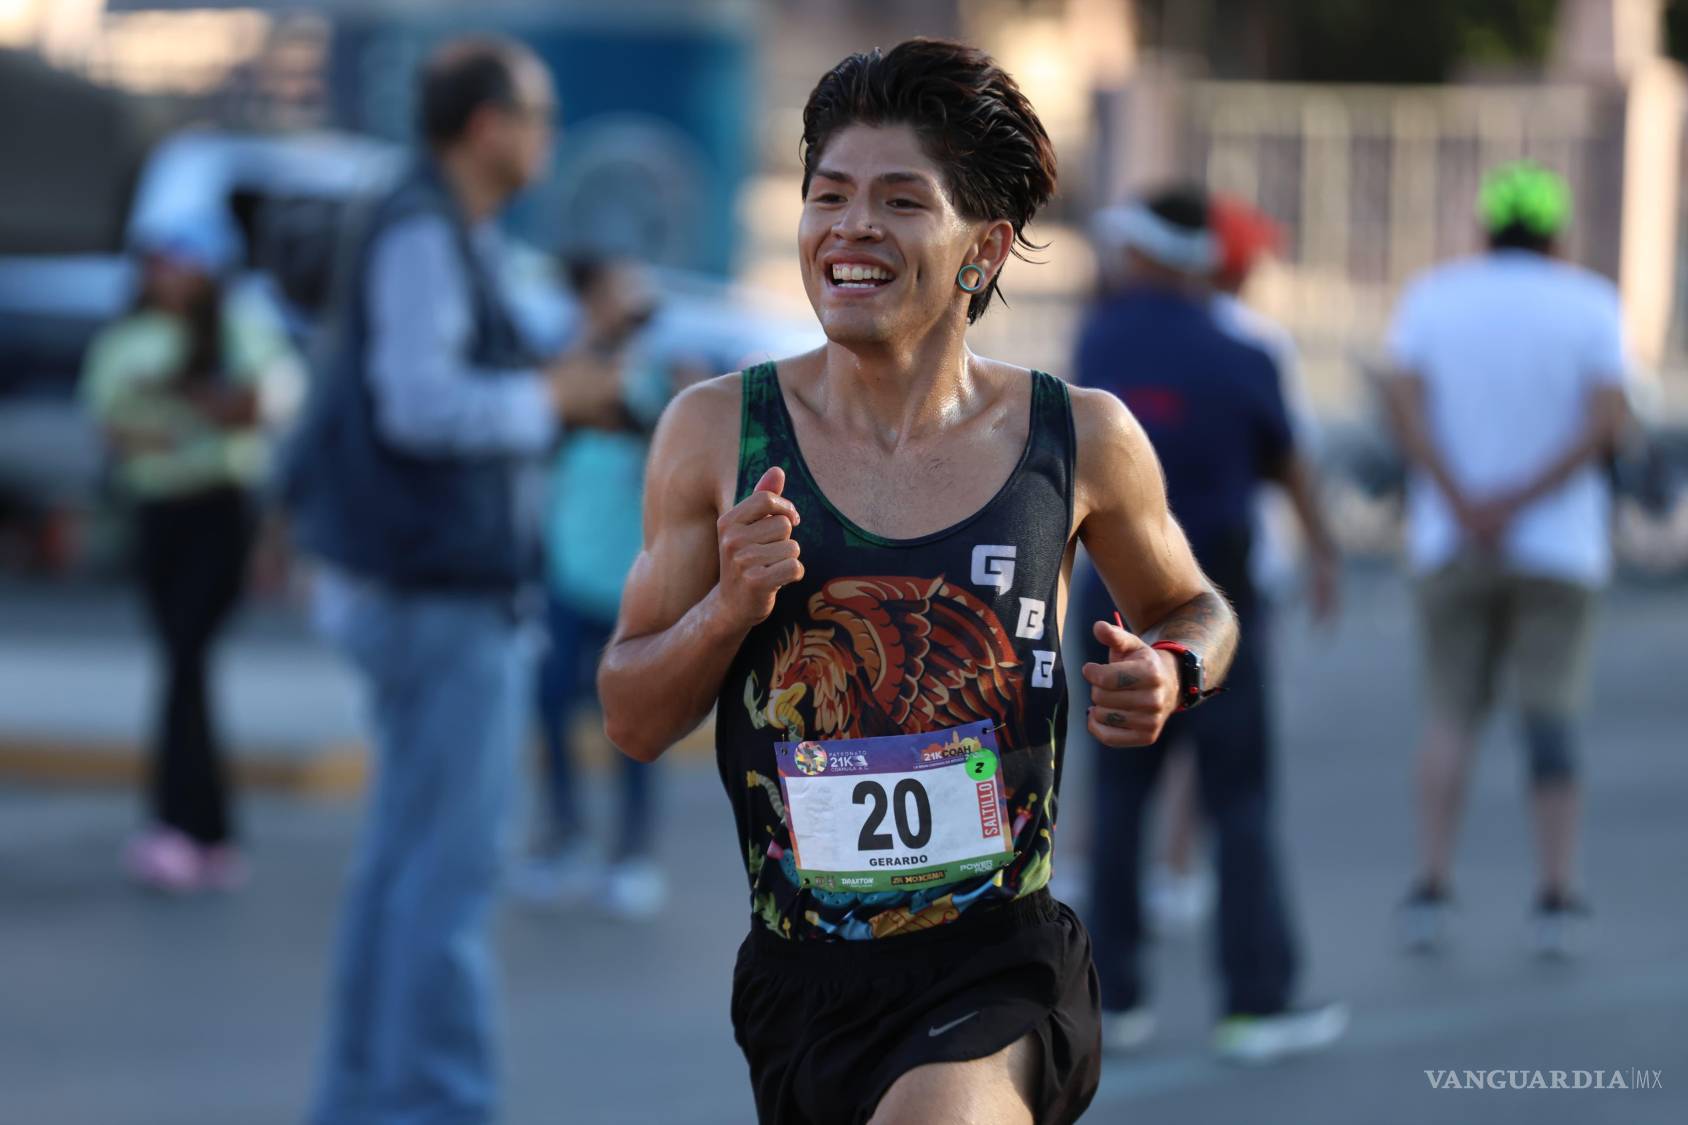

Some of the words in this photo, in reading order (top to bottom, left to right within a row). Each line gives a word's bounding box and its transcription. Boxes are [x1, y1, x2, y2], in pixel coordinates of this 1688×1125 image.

[971, 544, 1017, 596] G
[1015, 597, 1046, 640] B
[1031, 650, 1057, 688] G
[830, 757, 854, 768] 21K
[852, 778, 932, 852] 20
[980, 782, 999, 837] SALTILLO
[869, 854, 928, 867] GERARDO
